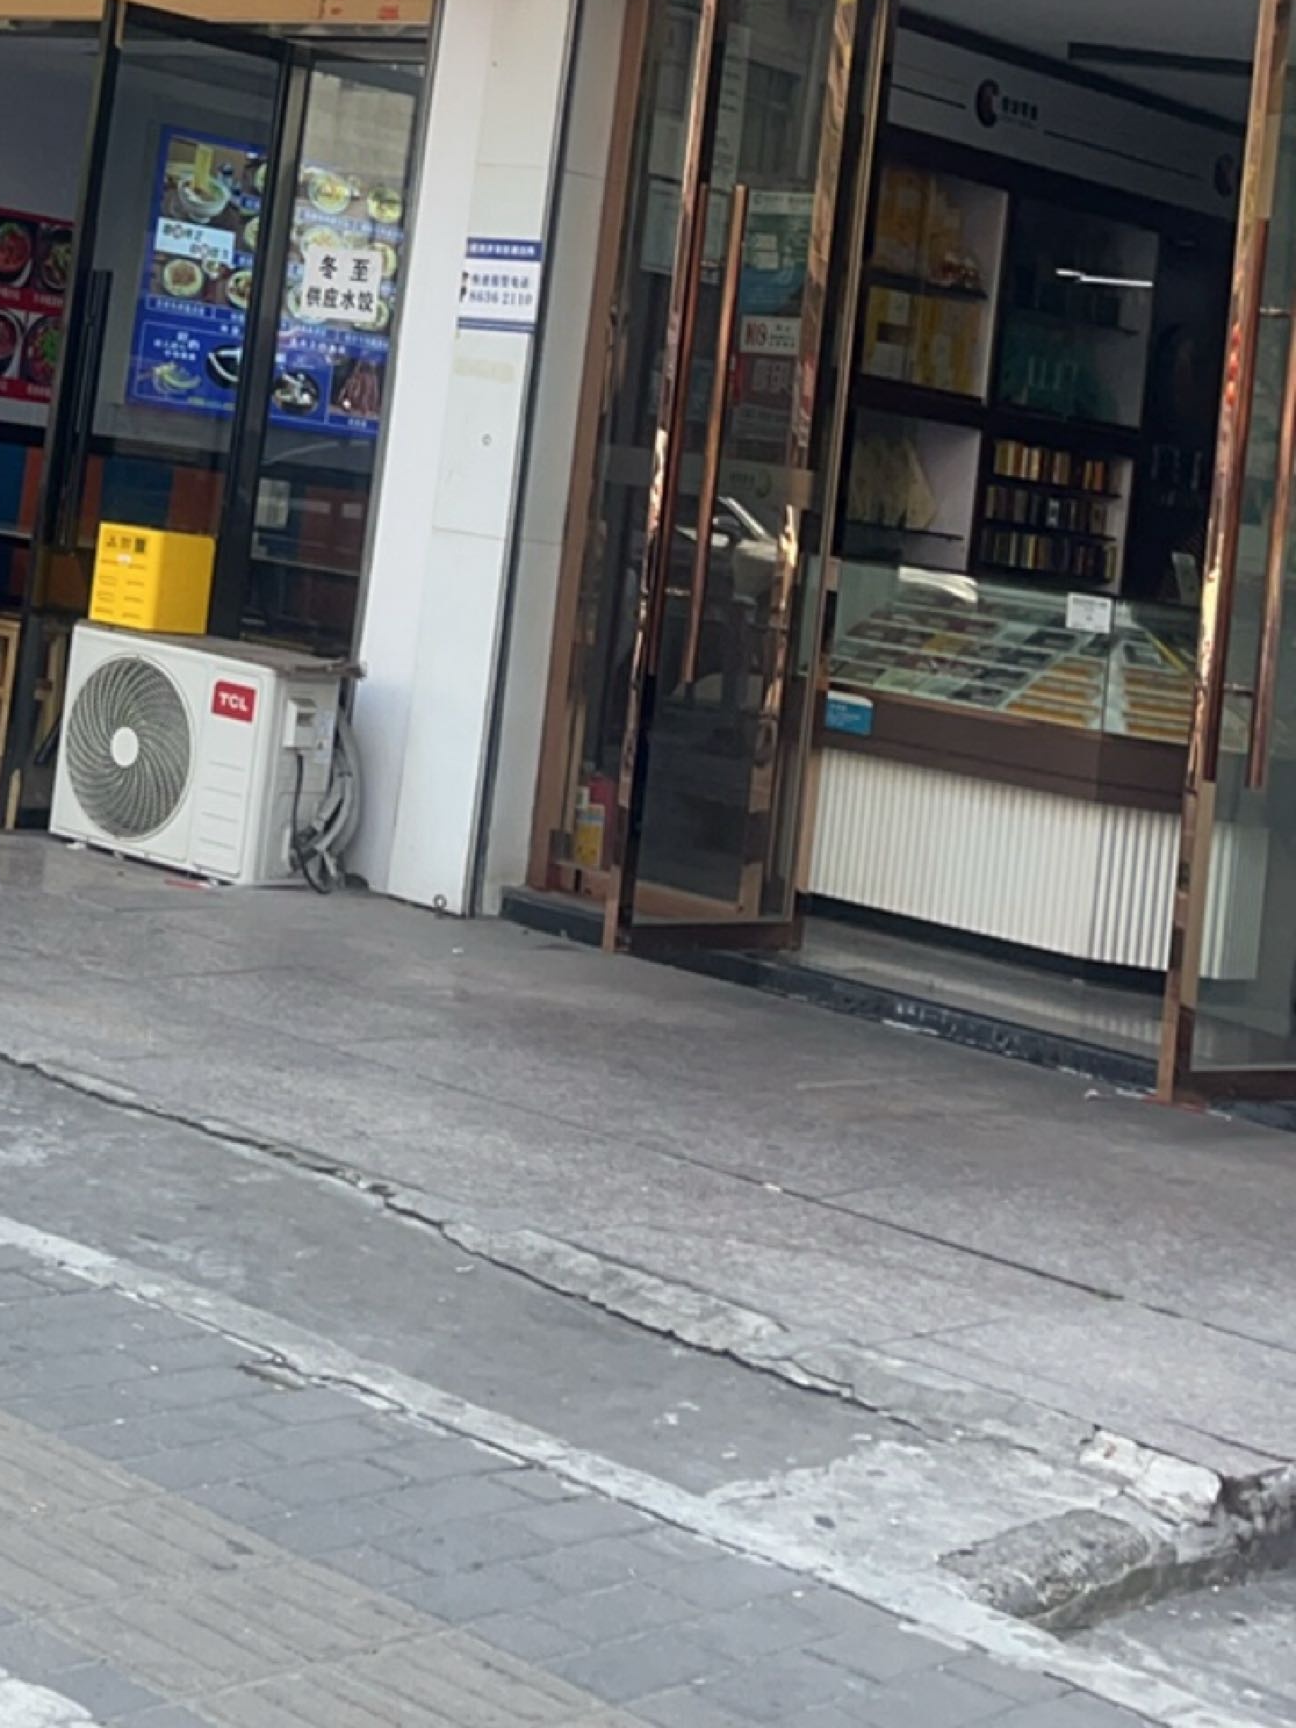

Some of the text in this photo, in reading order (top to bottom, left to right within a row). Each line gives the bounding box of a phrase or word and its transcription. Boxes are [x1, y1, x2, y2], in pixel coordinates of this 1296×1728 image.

[318, 253, 370, 282] 冬至
[306, 286, 374, 313] 供应水饺
[218, 691, 249, 713] TCL
